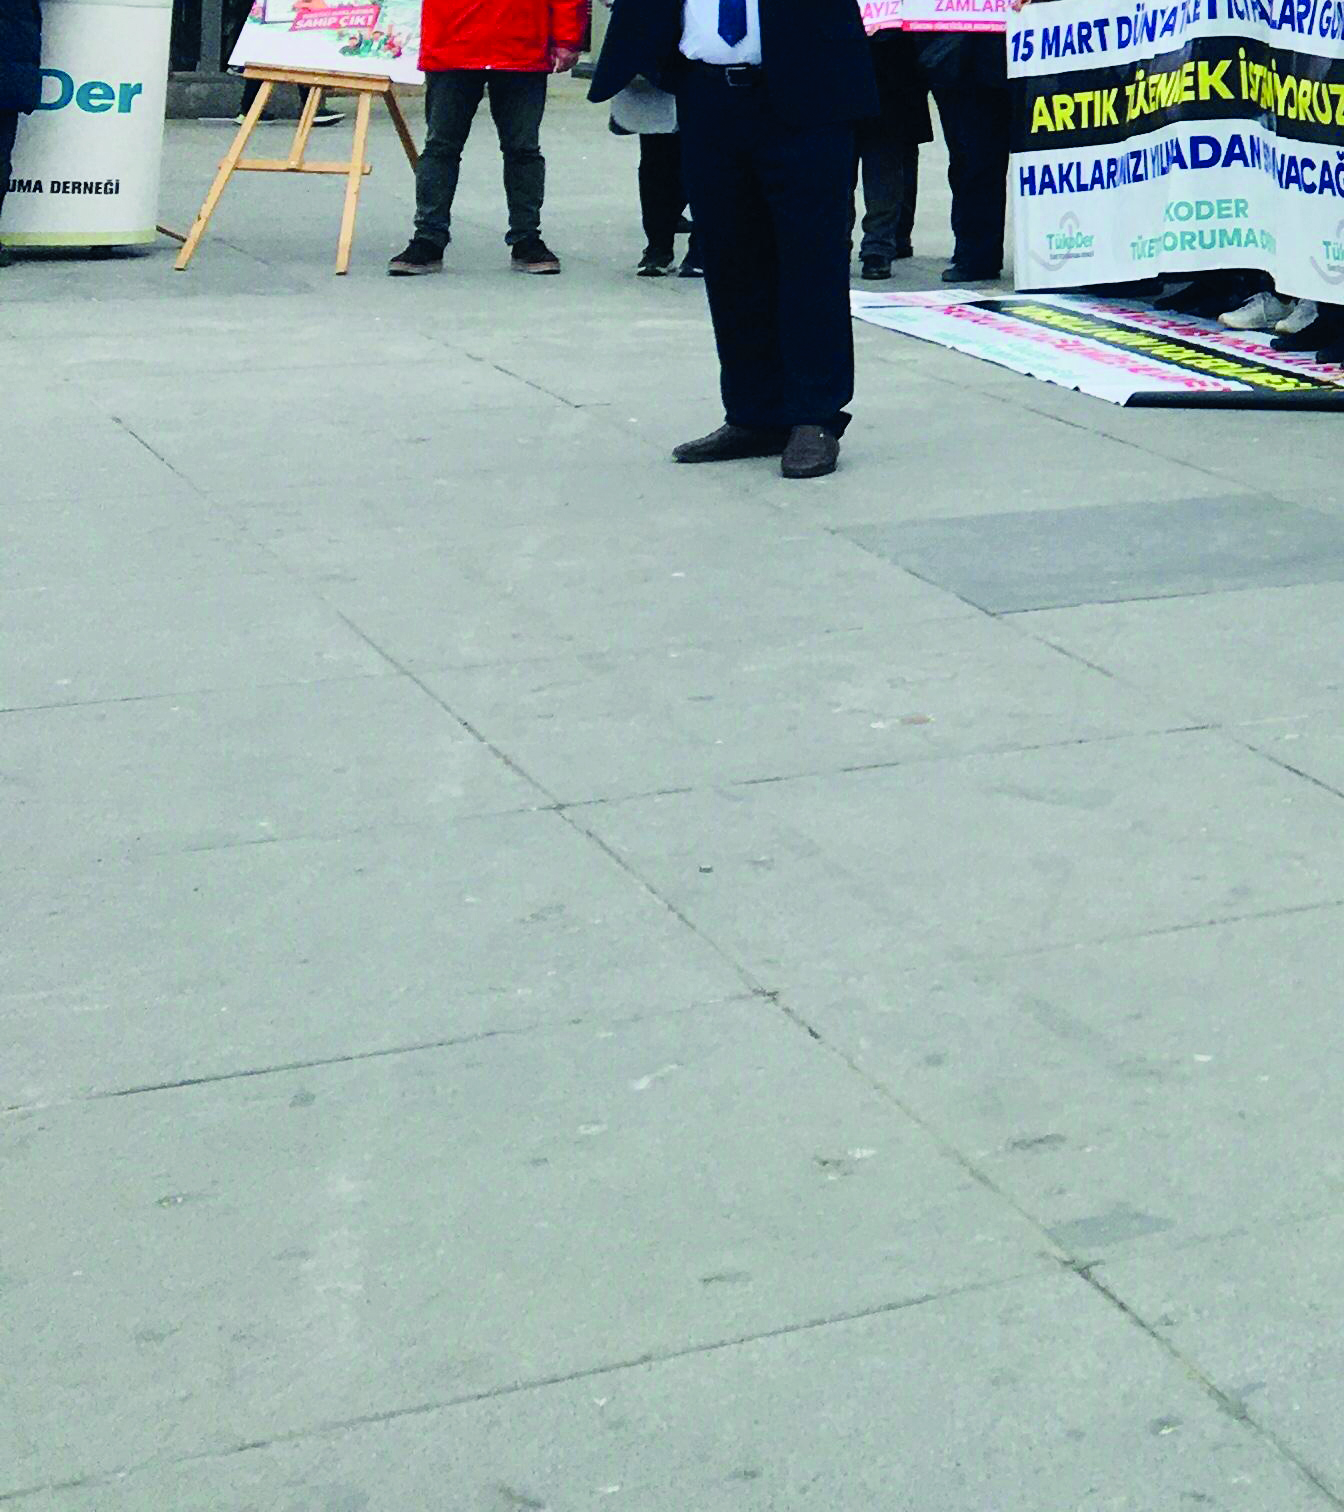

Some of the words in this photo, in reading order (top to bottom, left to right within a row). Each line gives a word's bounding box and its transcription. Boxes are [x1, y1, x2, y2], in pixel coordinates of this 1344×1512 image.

[1011, 28, 1035, 63] 15
[1040, 17, 1110, 60] MART
[1030, 87, 1120, 134] ARTIK
[50, 179, 121, 195] DERNEĞİ
[1163, 228, 1260, 253] ORUMA
